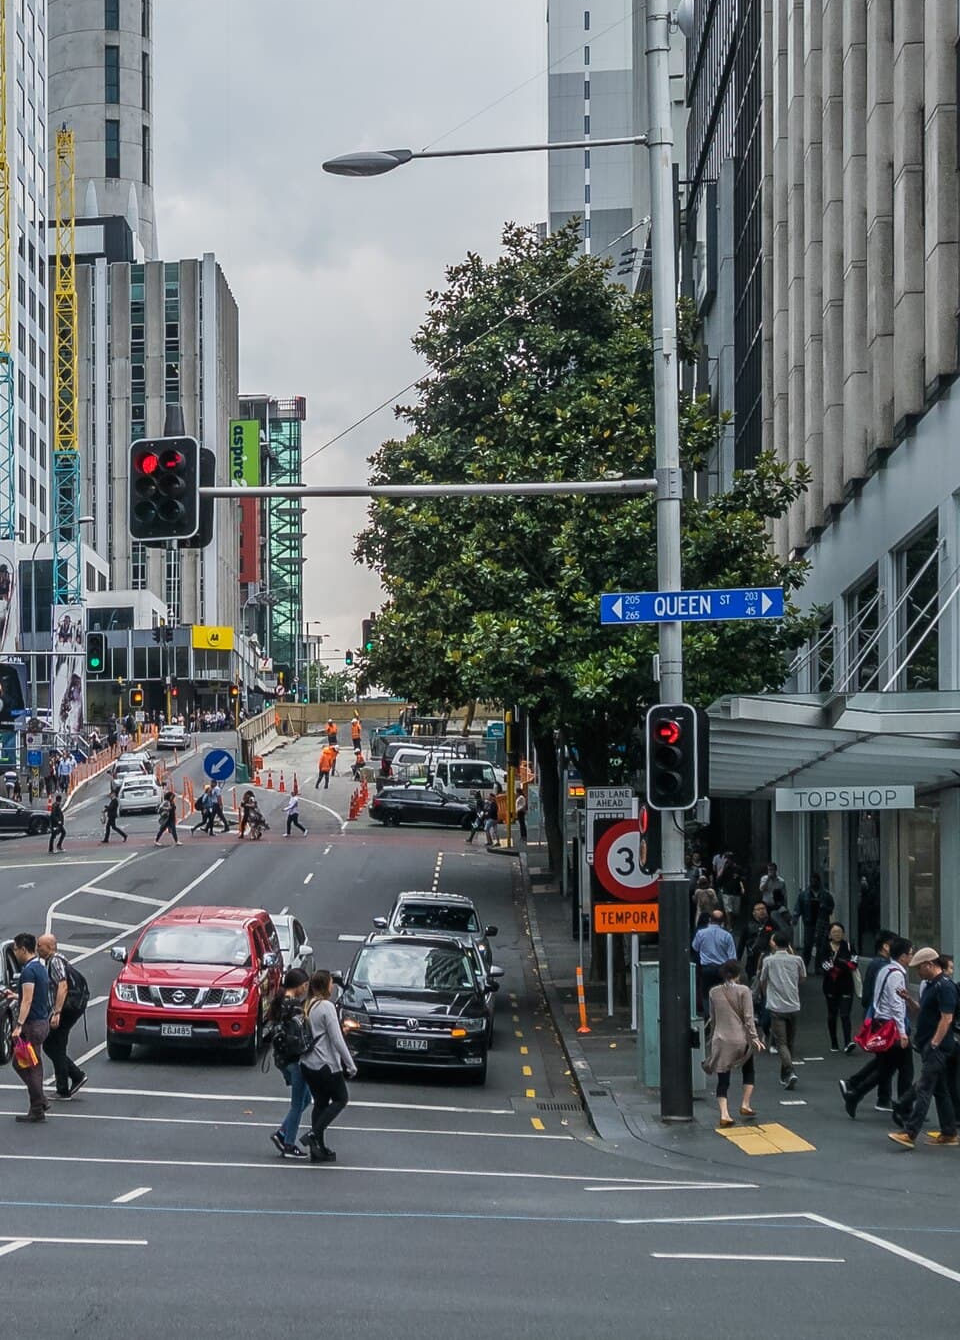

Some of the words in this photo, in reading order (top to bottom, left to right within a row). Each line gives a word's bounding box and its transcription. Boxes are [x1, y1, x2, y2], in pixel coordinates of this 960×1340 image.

[624, 595, 640, 605] 205
[654, 595, 711, 617] QUEEN
[719, 594, 731, 606] ST
[744, 591, 758, 601] 203
[625, 611, 640, 621] 265
[745, 606, 756, 616] 45
[210, 633, 219, 641] AA
[590, 790, 604, 798] BUS
[608, 790, 630, 798] LANE
[794, 789, 898, 808] TOPSHOP
[596, 799, 623, 807] AHEAD
